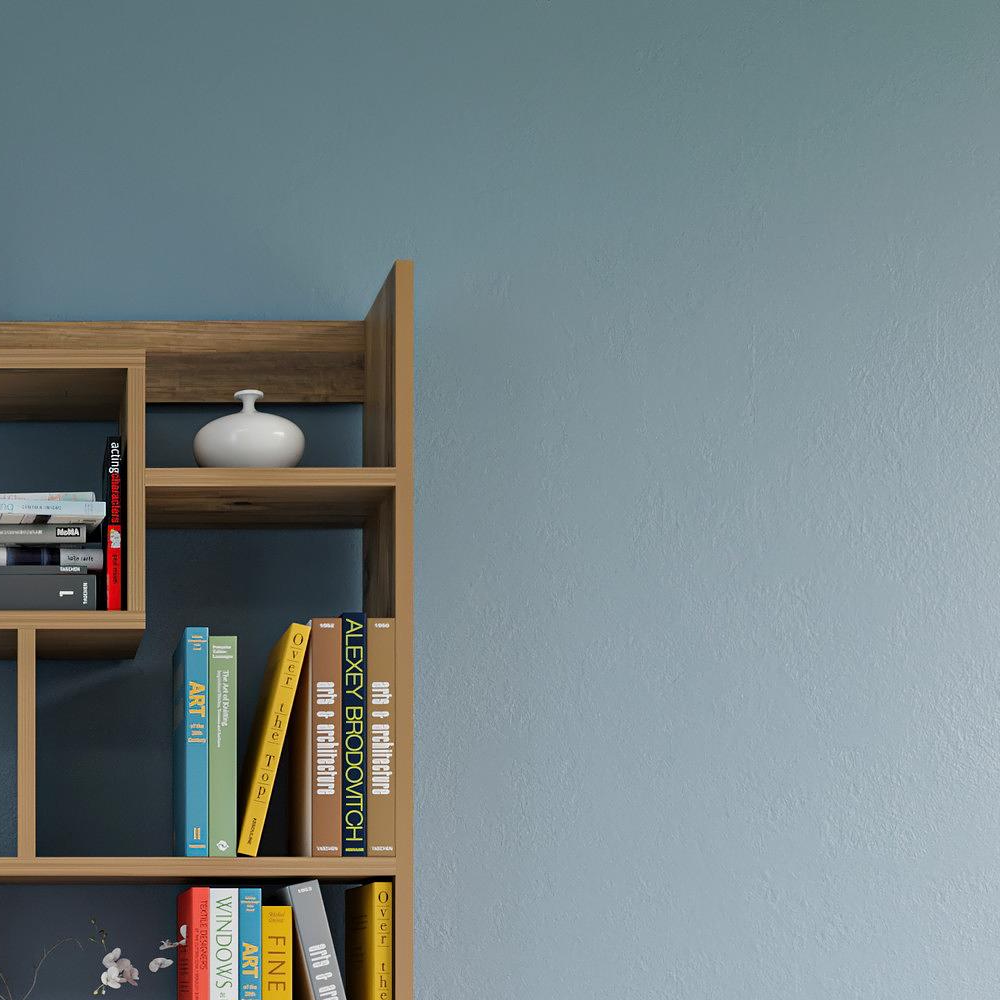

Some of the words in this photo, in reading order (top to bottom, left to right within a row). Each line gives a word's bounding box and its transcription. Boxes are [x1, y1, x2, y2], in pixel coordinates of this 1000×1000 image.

[285, 633, 304, 685] Over
[346, 618, 363, 699] ALEXEY
[188, 681, 206, 717] ART
[317, 681, 337, 704] arts
[317, 711, 336, 719] &
[371, 681, 392, 704] arts
[371, 711, 391, 719] &
[257, 754, 275, 800] Top
[317, 724, 339, 795] architecture
[346, 706, 363, 840] BRODOVITCH
[371, 724, 394, 795] architecture
[378, 891, 389, 945] Over
[216, 896, 232, 989] WINDOWS
[242, 943, 259, 978] ART
[267, 936, 286, 991] FINE
[308, 943, 331, 968] arts
[315, 972, 332, 981] &
